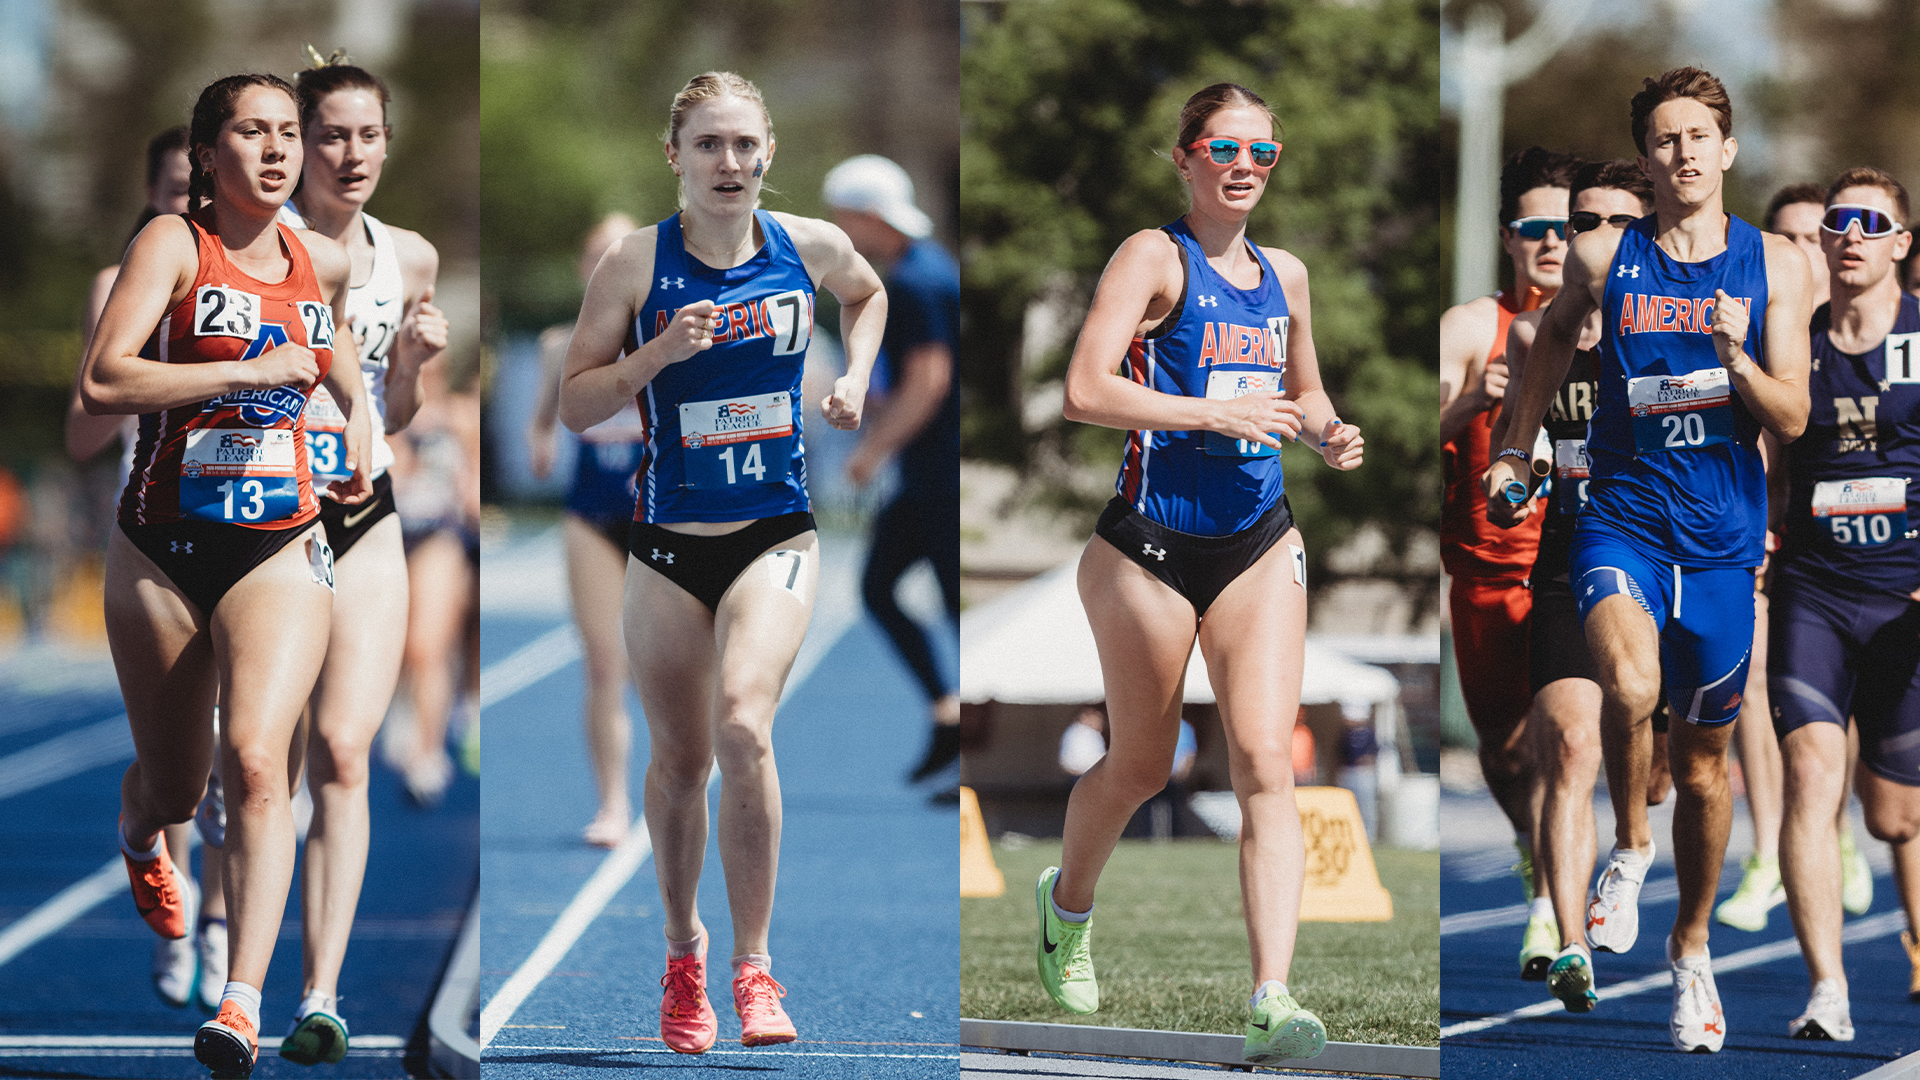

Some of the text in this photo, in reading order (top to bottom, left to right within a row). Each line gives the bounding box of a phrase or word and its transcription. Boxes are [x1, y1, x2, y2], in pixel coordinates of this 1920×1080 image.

[200, 289, 252, 335] 23
[776, 296, 800, 352] 7
[1550, 381, 1598, 422] AR
[1657, 386, 1699, 397] PATRIOT
[1658, 391, 1700, 403] LEAGUE
[715, 412, 761, 426] PATRIOT
[715, 419, 762, 432] LEAGUE
[1661, 412, 1706, 448] 20
[1833, 396, 1879, 440] N
[216, 447, 264, 456] PATRIOT
[216, 454, 265, 463] LEAGUE
[718, 443, 767, 485] 14
[216, 479, 265, 520] 13
[1831, 514, 1891, 545] 510
[776, 551, 802, 591] 7
